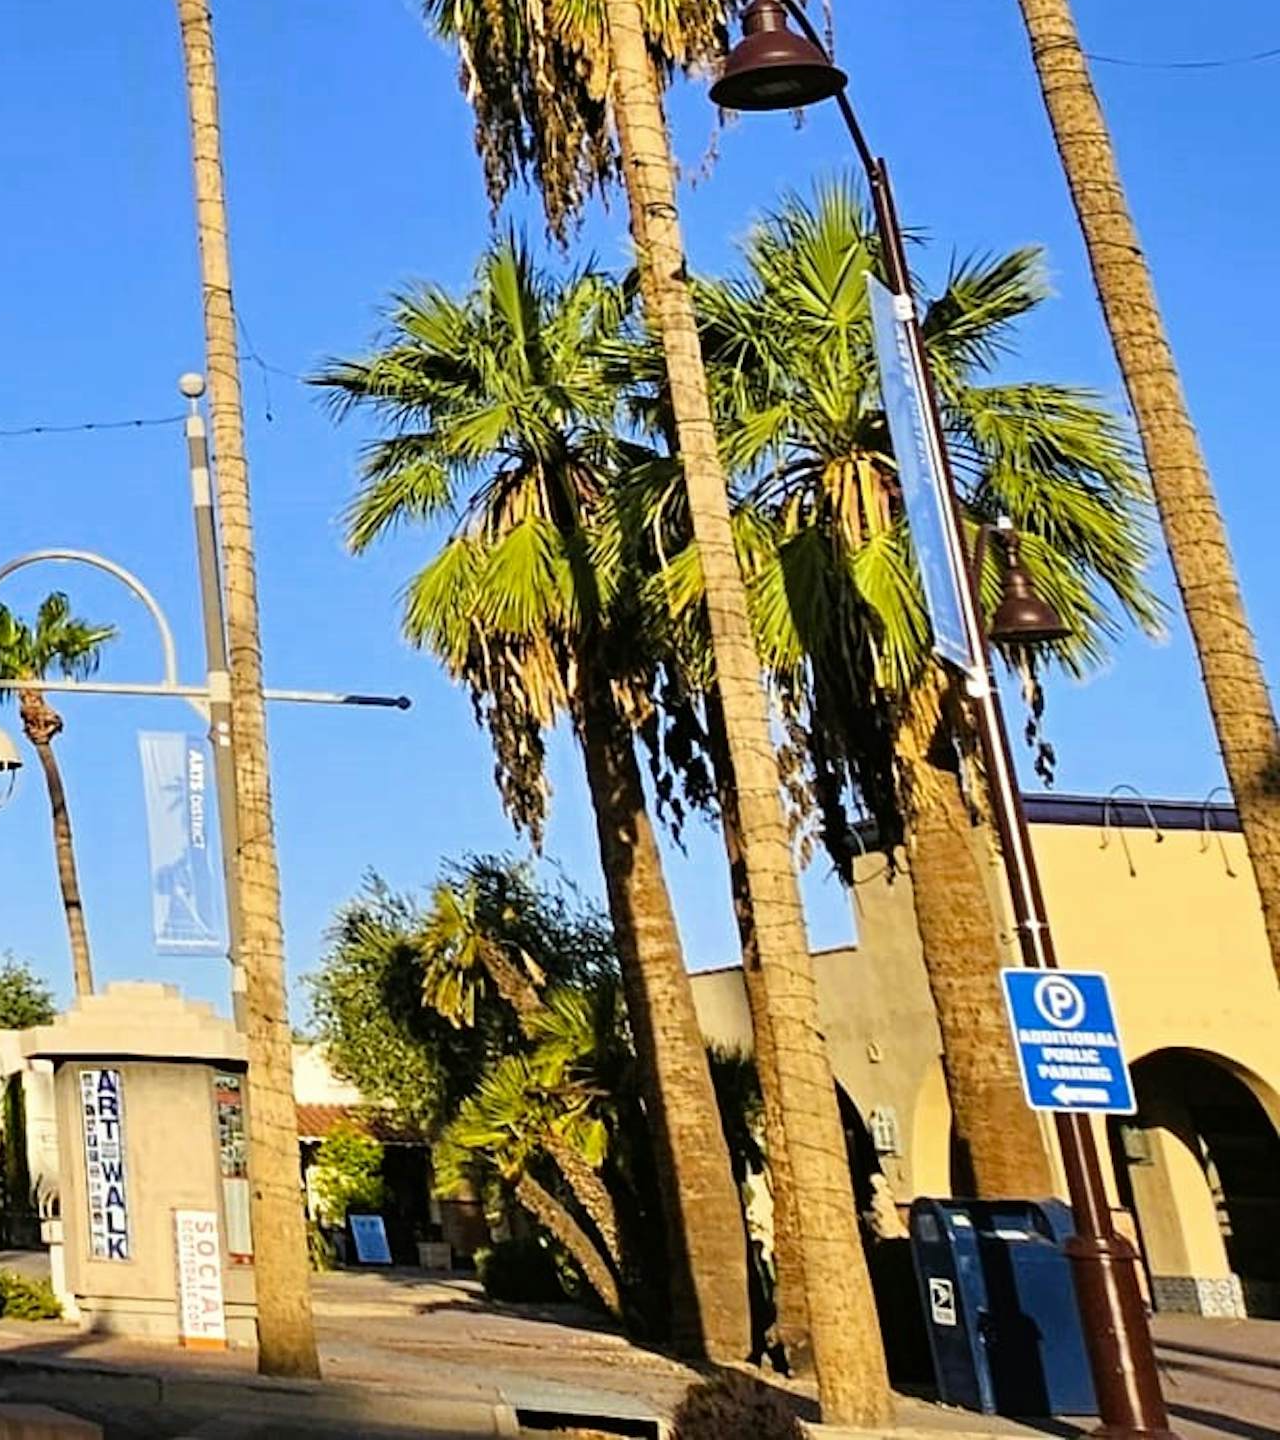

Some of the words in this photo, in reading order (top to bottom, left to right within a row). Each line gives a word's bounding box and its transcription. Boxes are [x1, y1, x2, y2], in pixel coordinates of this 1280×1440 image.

[189, 748, 205, 791] ARTS
[1047, 986, 1074, 1019] P
[1019, 1028, 1118, 1048] ADDITIONAL
[1041, 1046, 1102, 1064] PUBLIC
[1036, 1063, 1113, 1082] PARKING
[195, 1221, 221, 1332] SOCIAL
